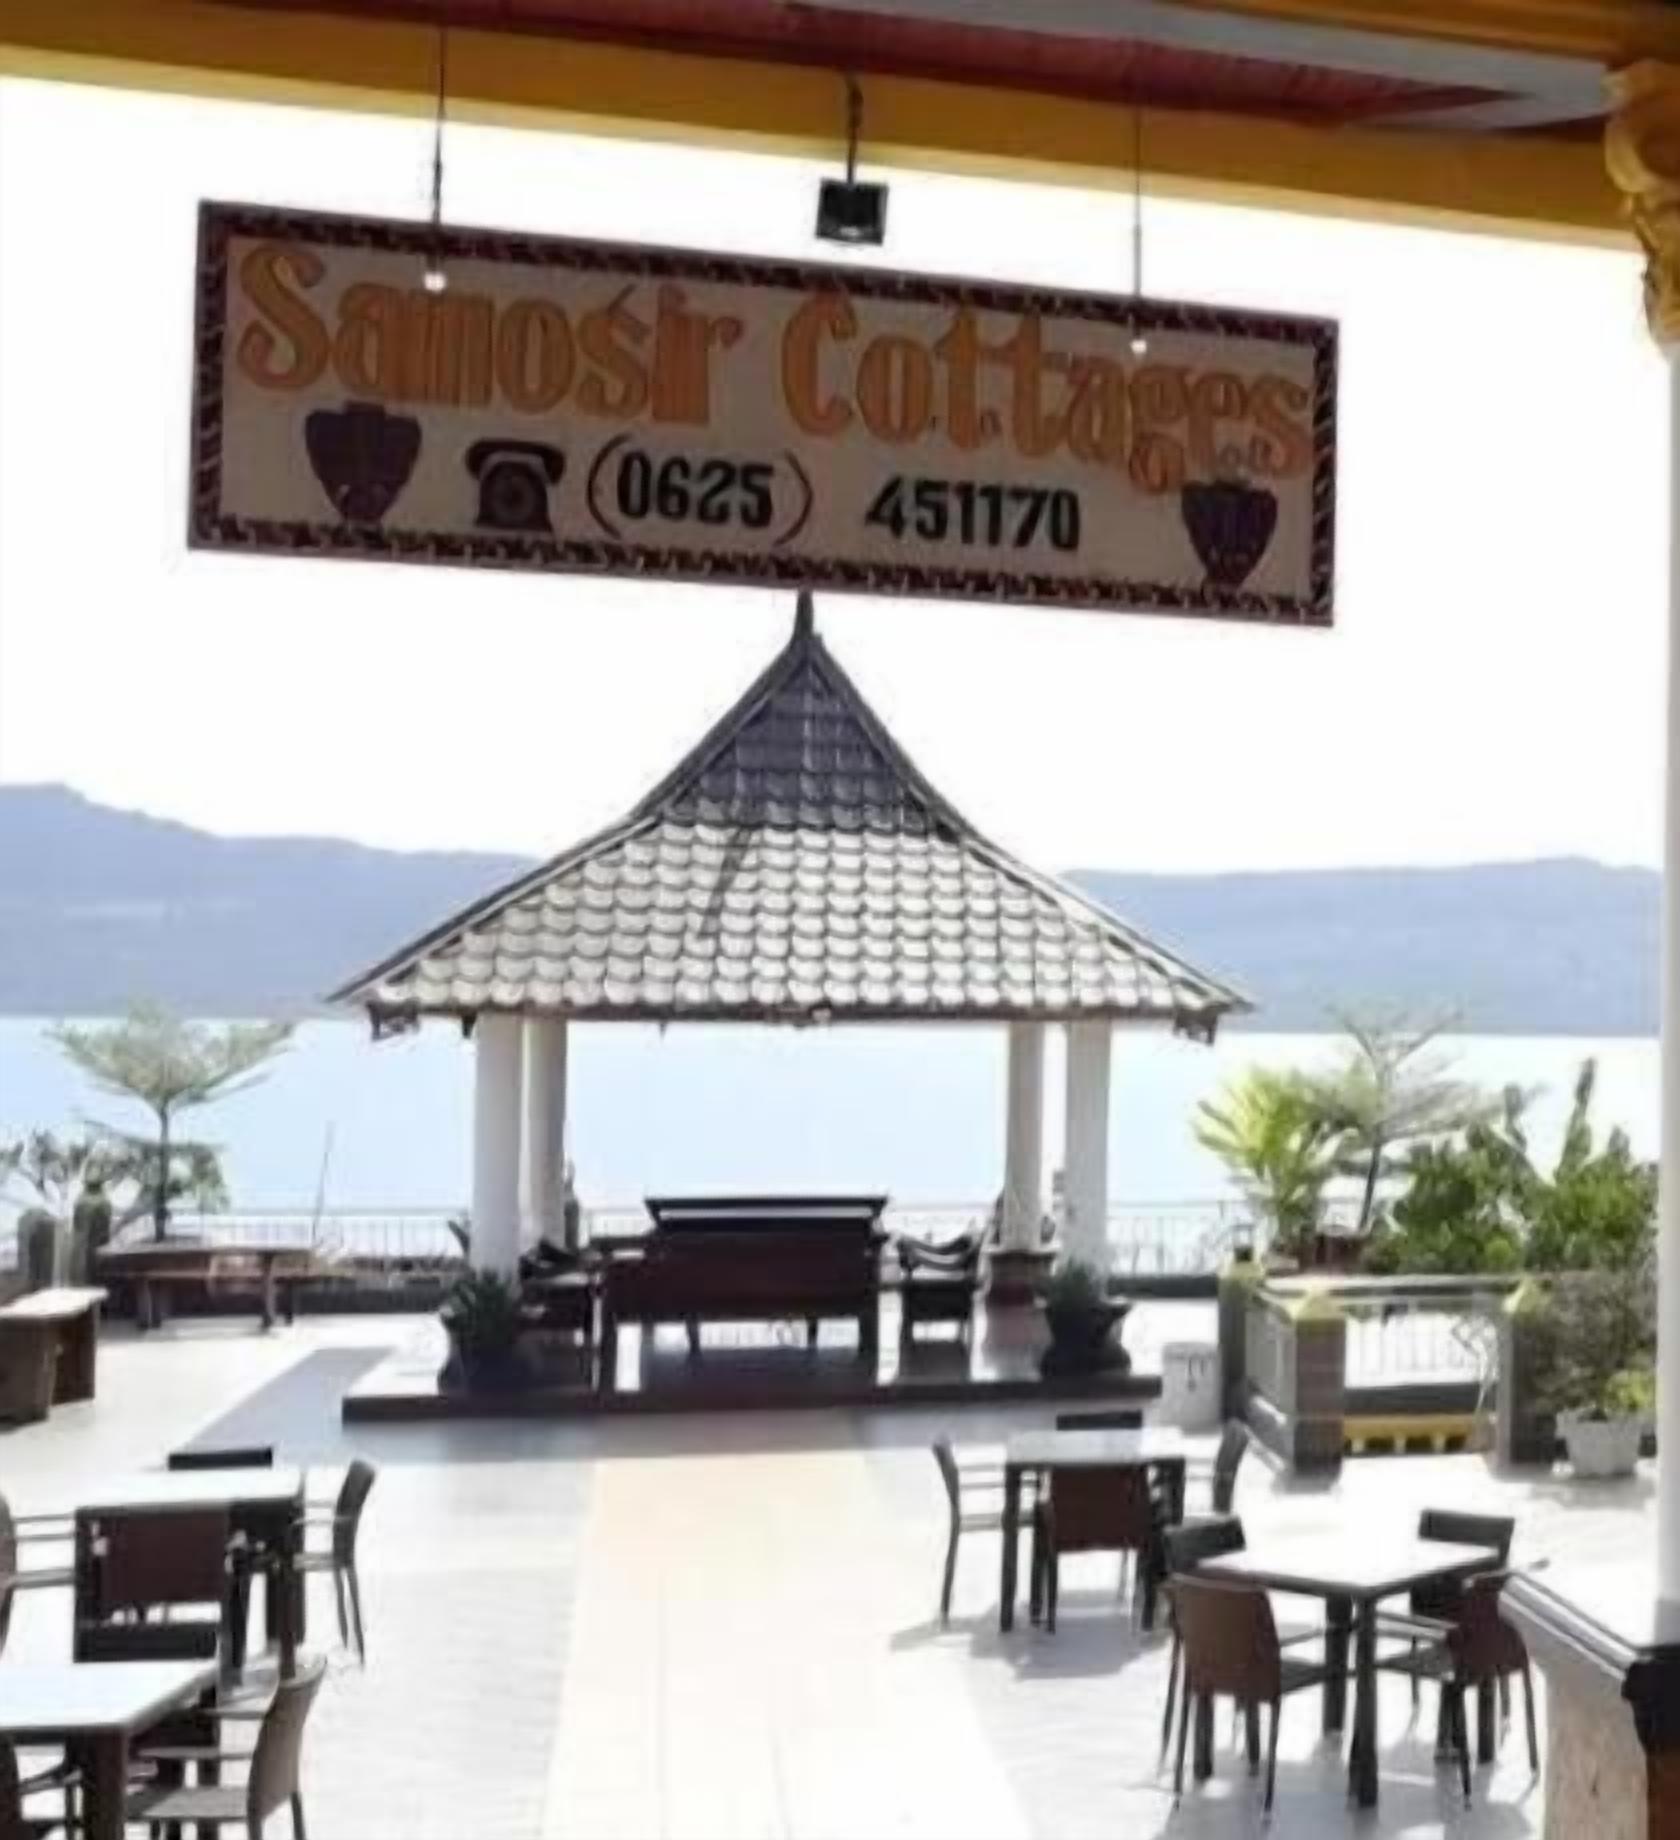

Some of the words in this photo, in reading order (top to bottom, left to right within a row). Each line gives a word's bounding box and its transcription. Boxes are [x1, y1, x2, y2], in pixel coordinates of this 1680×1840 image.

[236, 244, 744, 426] Samosir
[780, 283, 1311, 494] Cottages
[588, 433, 814, 545] (0625)
[864, 476, 1081, 552] 451170
